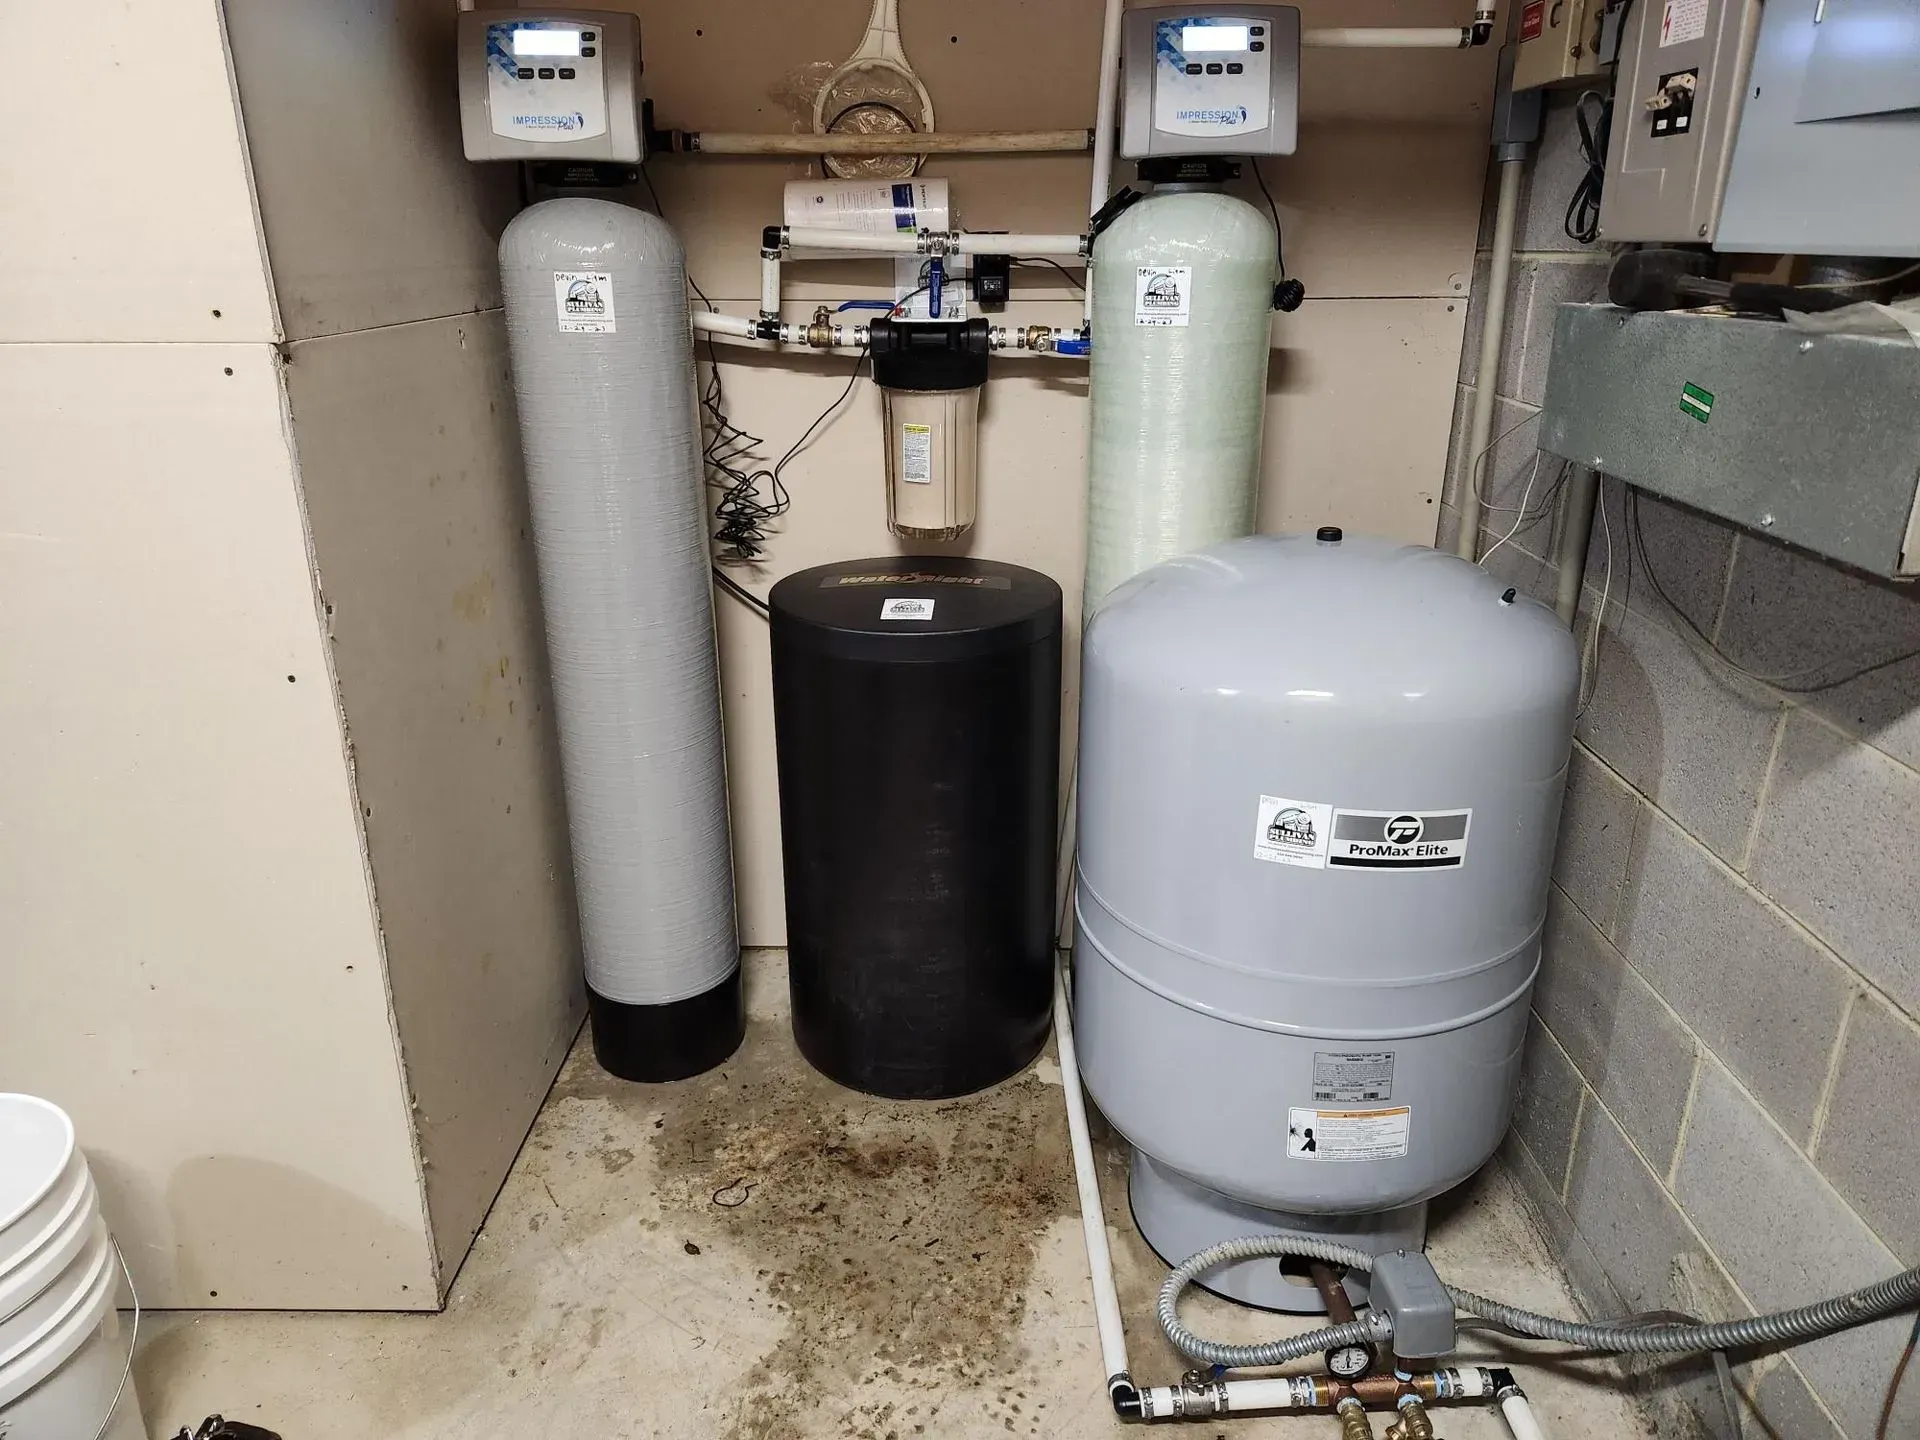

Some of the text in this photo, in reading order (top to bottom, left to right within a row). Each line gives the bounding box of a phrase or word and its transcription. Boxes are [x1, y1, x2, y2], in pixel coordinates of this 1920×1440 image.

[512, 115, 575, 125] IMPRESSION
[1176, 110, 1239, 120] IMPRESSION
[1219, 115, 1236, 125] Plus
[1269, 827, 1315, 841] SULLIVAN
[1268, 834, 1315, 847] PLUMBING
[1349, 844, 1449, 856] ProMax Elite
